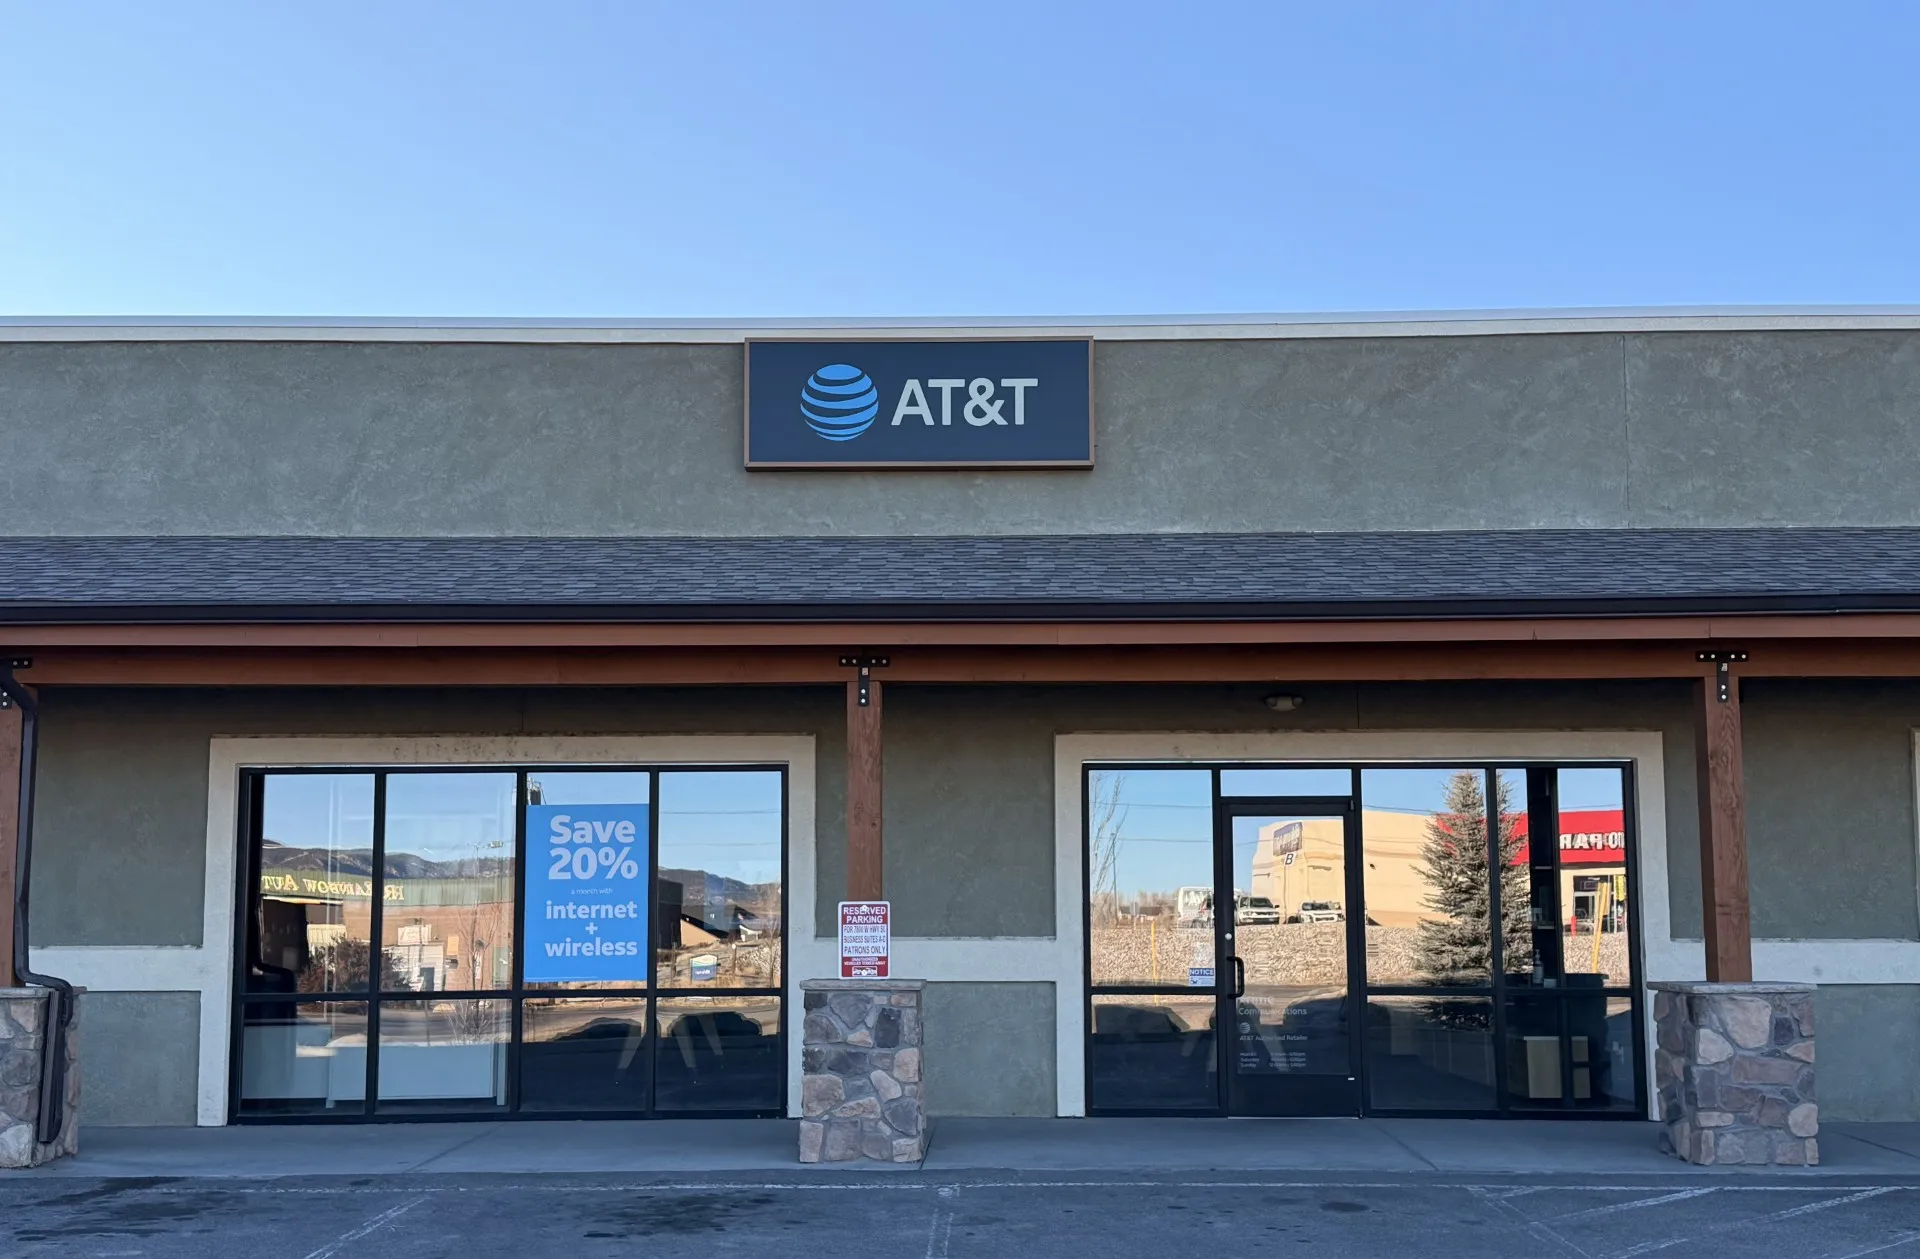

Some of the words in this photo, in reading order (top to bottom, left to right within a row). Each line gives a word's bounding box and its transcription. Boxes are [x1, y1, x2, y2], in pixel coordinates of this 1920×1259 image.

[891, 377, 1038, 426] AT&T
[549, 814, 636, 845] Save
[548, 846, 639, 880] 20%
[546, 900, 638, 920] internet
[843, 906, 887, 915] RESERVED
[846, 915, 883, 924] PARKING
[545, 937, 638, 957] wireless
[844, 945, 870, 954] PATRONS
[871, 945, 885, 954] ONLY
